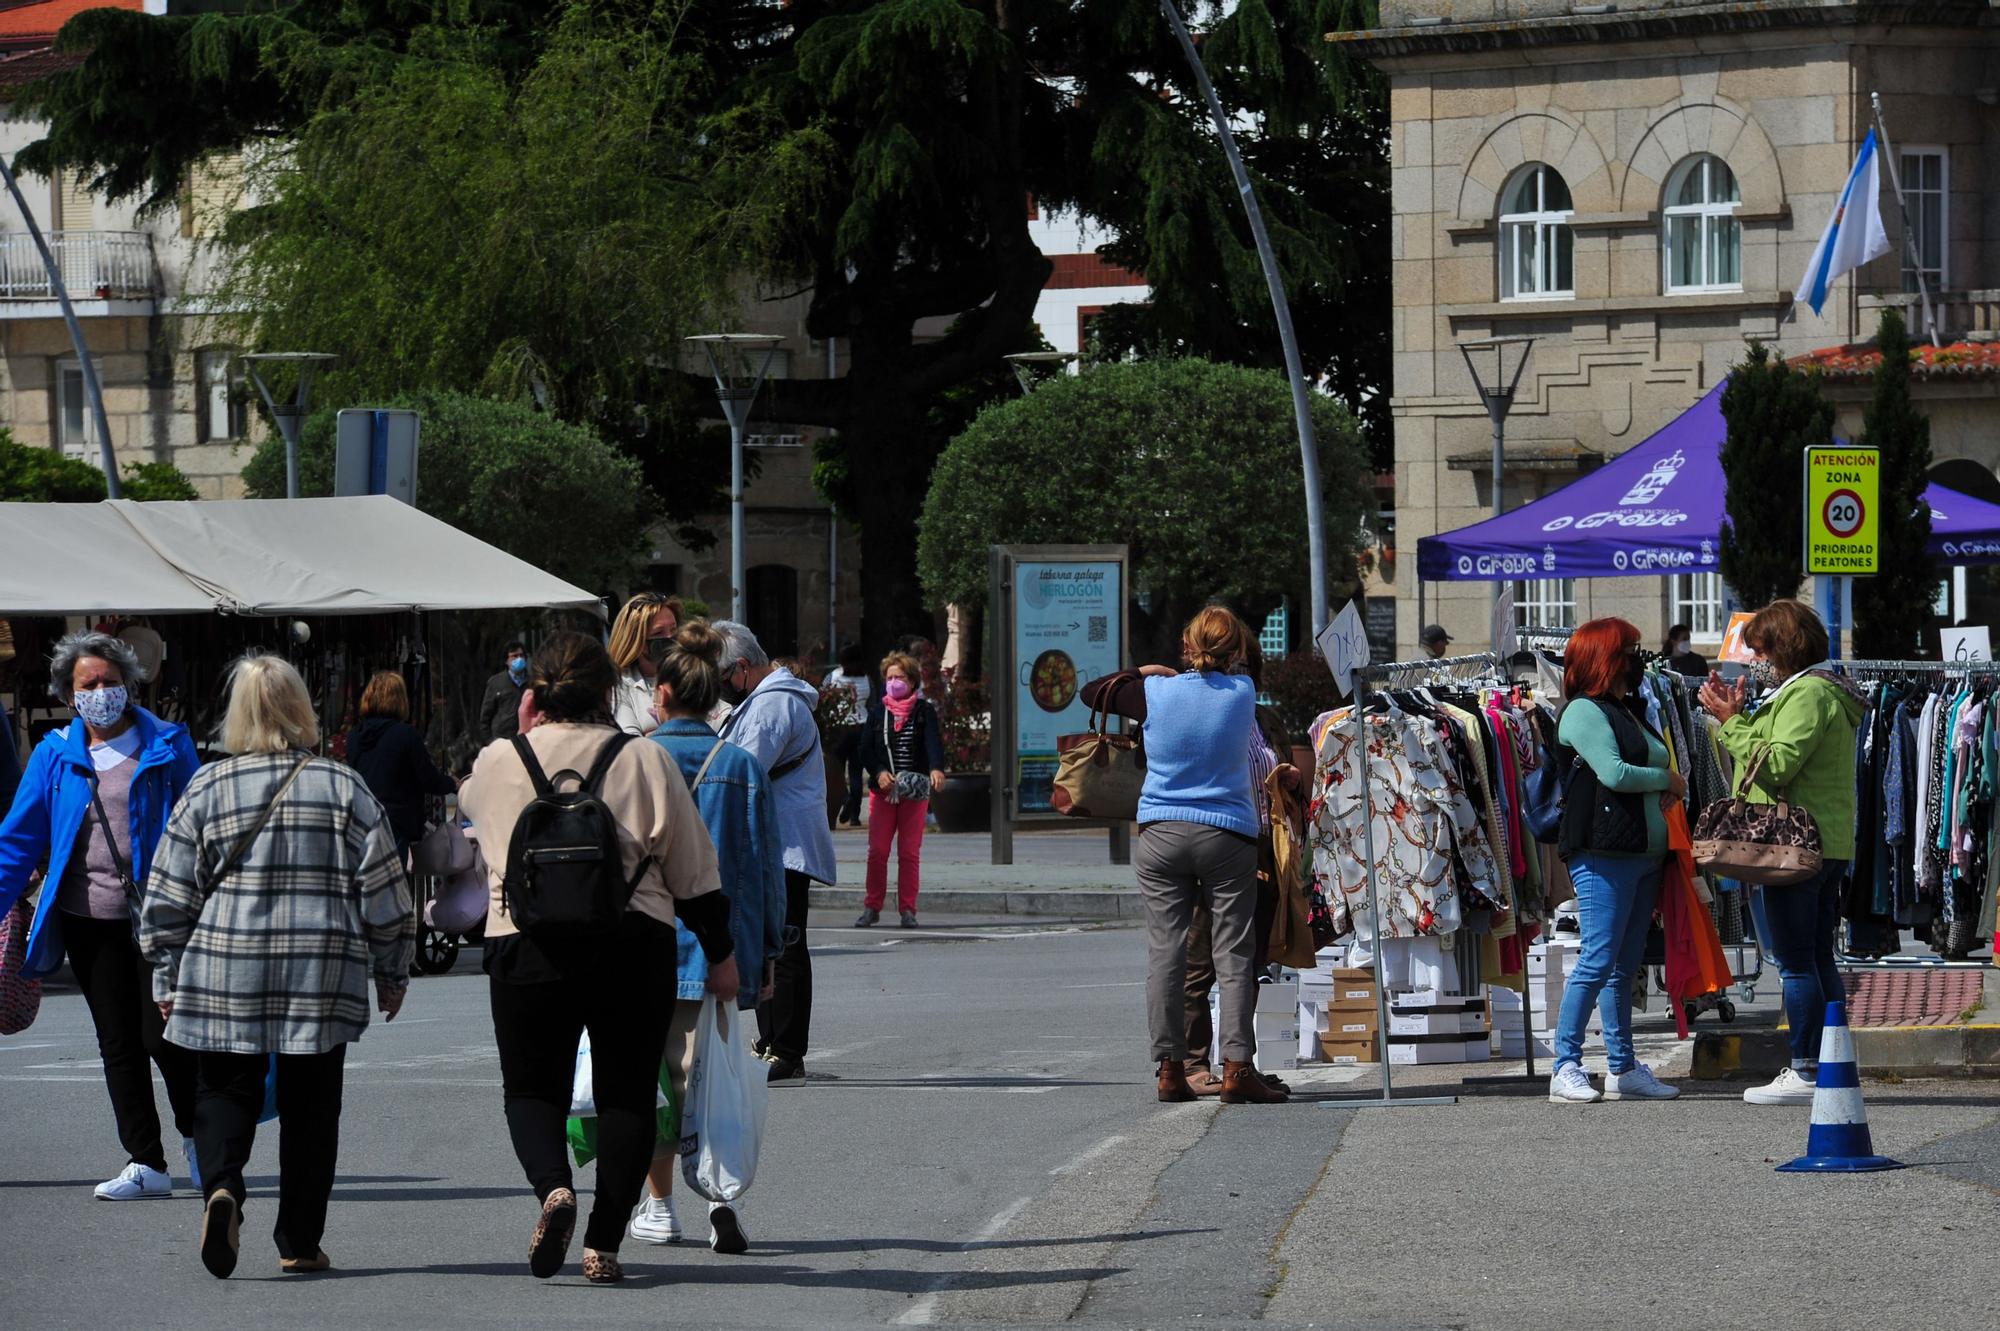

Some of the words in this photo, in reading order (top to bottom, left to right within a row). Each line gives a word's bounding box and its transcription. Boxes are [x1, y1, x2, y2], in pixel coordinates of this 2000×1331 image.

[1814, 453, 1876, 466] ATENCIÓN
[1826, 472, 1862, 483] ZONA
[1832, 505, 1855, 521] 20
[1542, 516, 1574, 531] O
[1814, 544, 1873, 554] PRIORIDAD
[1458, 555, 1473, 575] O
[1476, 555, 1536, 575] Grove
[1613, 550, 1628, 570] O
[1631, 550, 1695, 569] Grove
[1814, 557, 1872, 567] PEATONES
[1073, 568, 1104, 583] galega
